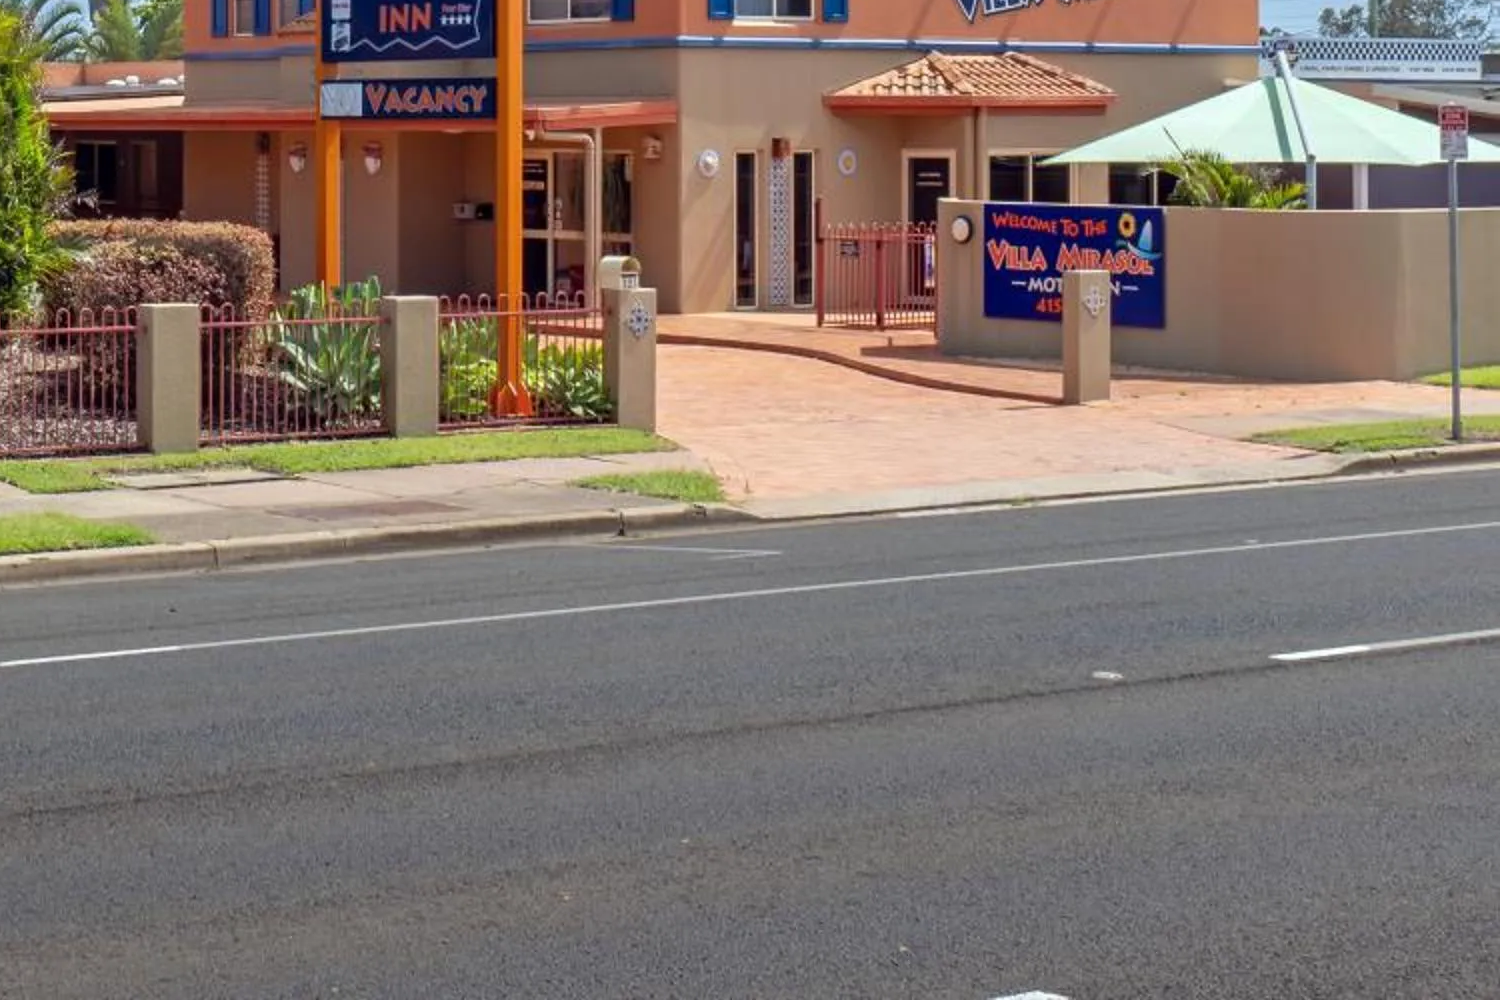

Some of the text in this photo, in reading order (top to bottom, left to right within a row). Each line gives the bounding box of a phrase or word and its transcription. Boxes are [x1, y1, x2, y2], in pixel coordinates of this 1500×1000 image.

[378, 2, 433, 33] INN
[365, 83, 488, 113] VACANCY
[991, 211, 1108, 237] WELCOME TO THE
[986, 238, 1156, 275] VILLA MIRASOL
[1027, 277, 1062, 293] MOT
